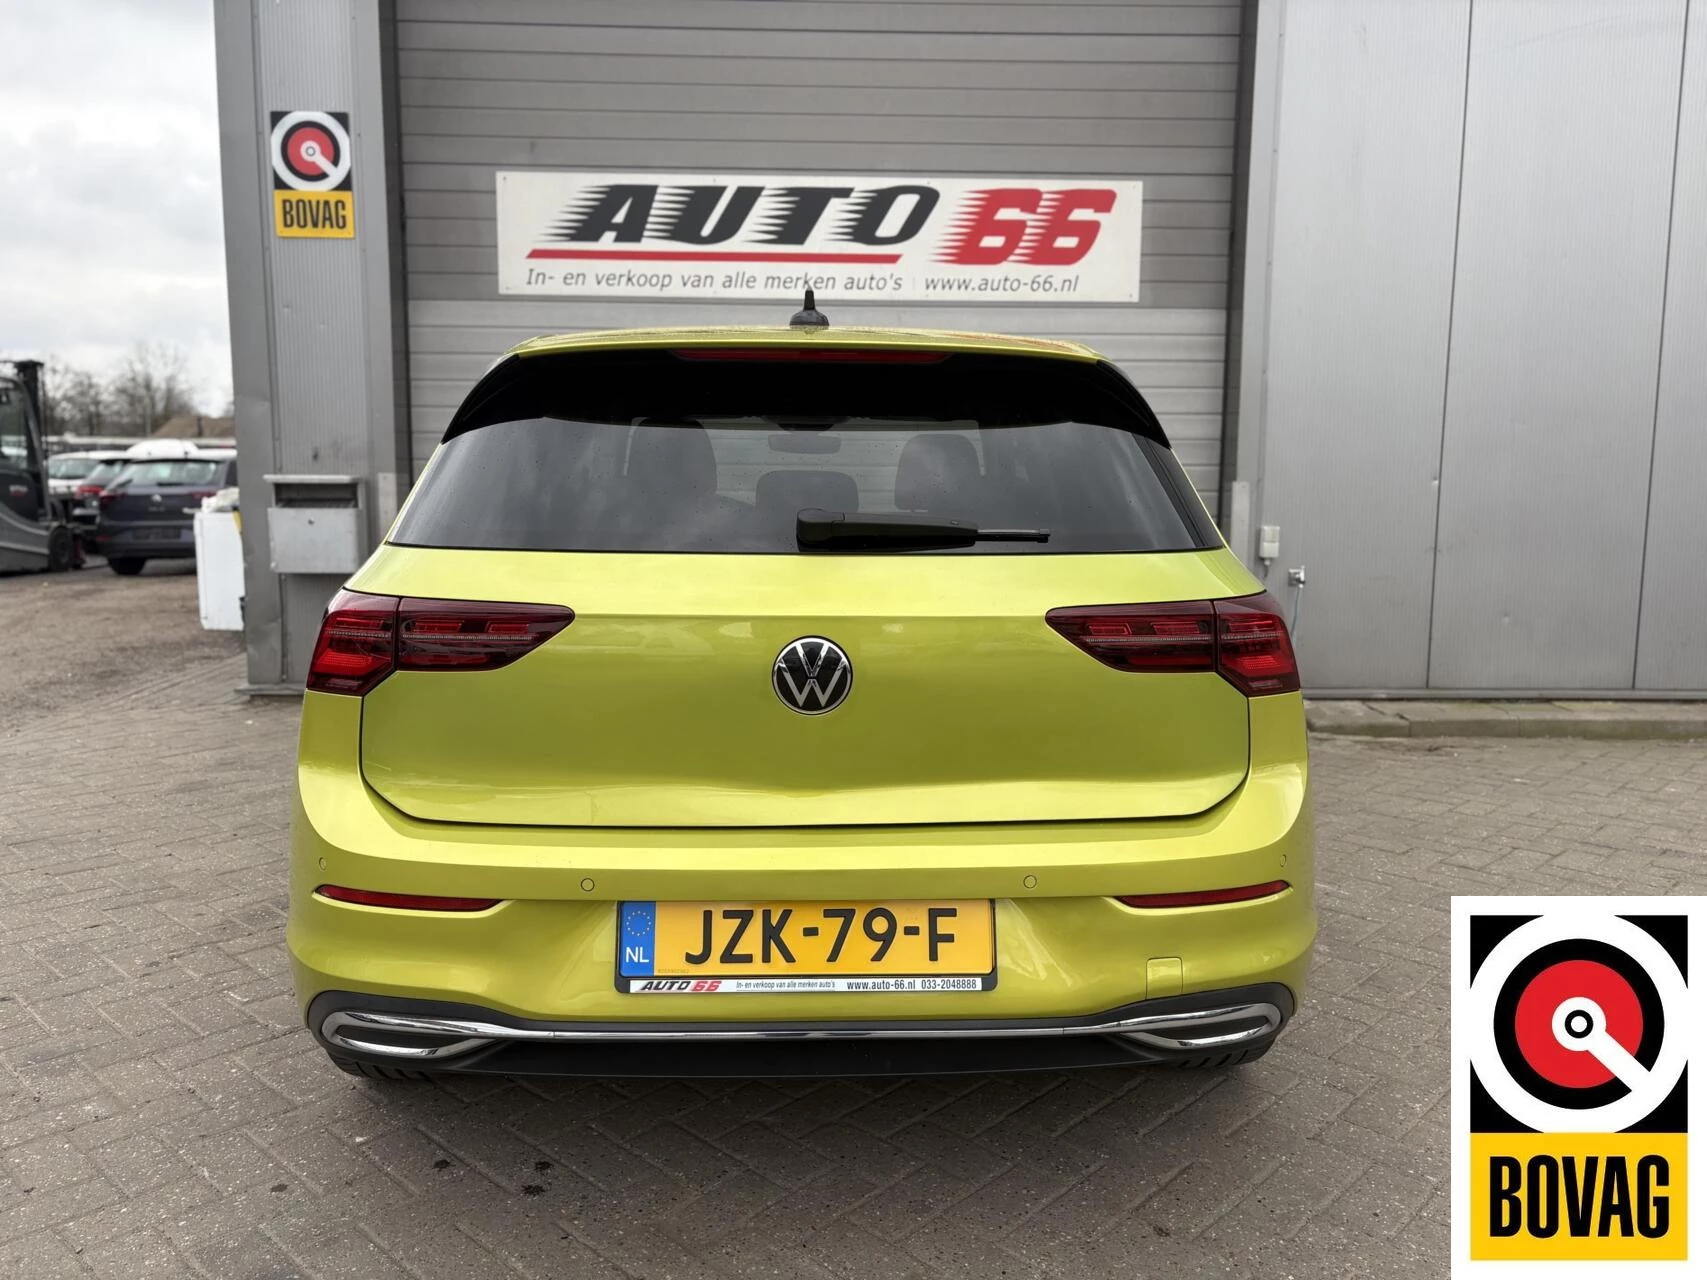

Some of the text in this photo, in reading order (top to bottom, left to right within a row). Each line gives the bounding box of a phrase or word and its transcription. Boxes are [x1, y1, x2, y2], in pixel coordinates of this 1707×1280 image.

[281, 198, 347, 229] BOVAG
[533, 184, 1118, 266] AUTO 66
[526, 268, 903, 292] In- en verkoop van alle merken auto's
[924, 275, 1079, 292] www.auto-66.nl
[684, 907, 958, 964] JZK-79-F
[625, 947, 649, 963] NL
[640, 980, 722, 992] AUTO 66
[753, 981, 775, 990] verkoop
[818, 980, 836, 988] auto's
[847, 979, 977, 990] www.auto-66.nl 033-2048888
